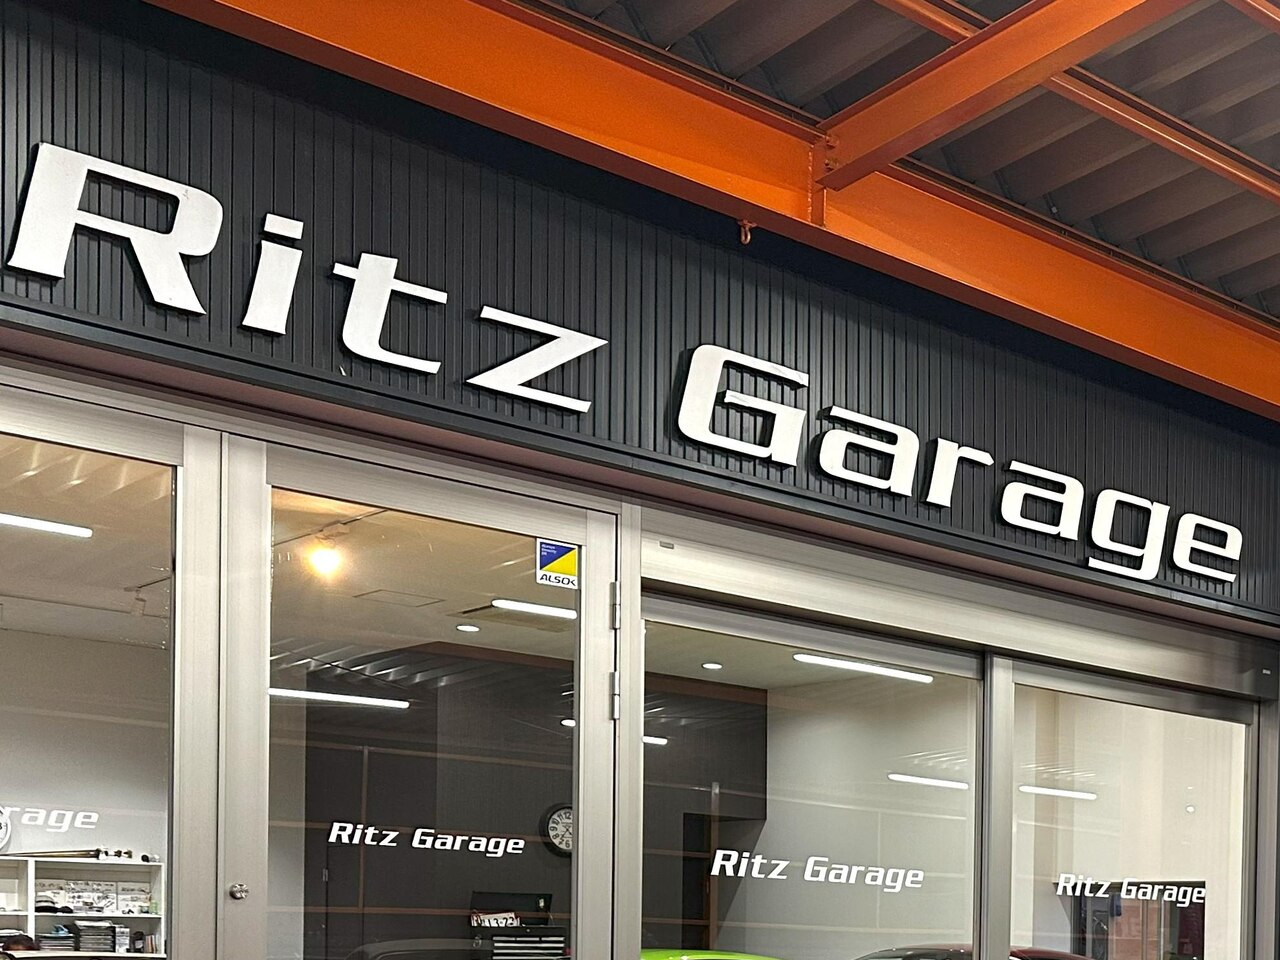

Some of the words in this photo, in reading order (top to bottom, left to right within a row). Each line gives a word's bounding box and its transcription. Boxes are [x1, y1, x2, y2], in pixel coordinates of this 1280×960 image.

[6, 142, 609, 413] Ritz
[677, 344, 1245, 583] Garage
[540, 573, 576, 587] ALSOK
[328, 821, 400, 847] Ritz
[411, 828, 526, 858] Garage
[710, 849, 791, 880] Ritz
[803, 855, 925, 893] Garage
[1056, 872, 1112, 898] Ritz
[1120, 877, 1206, 908] Garage
